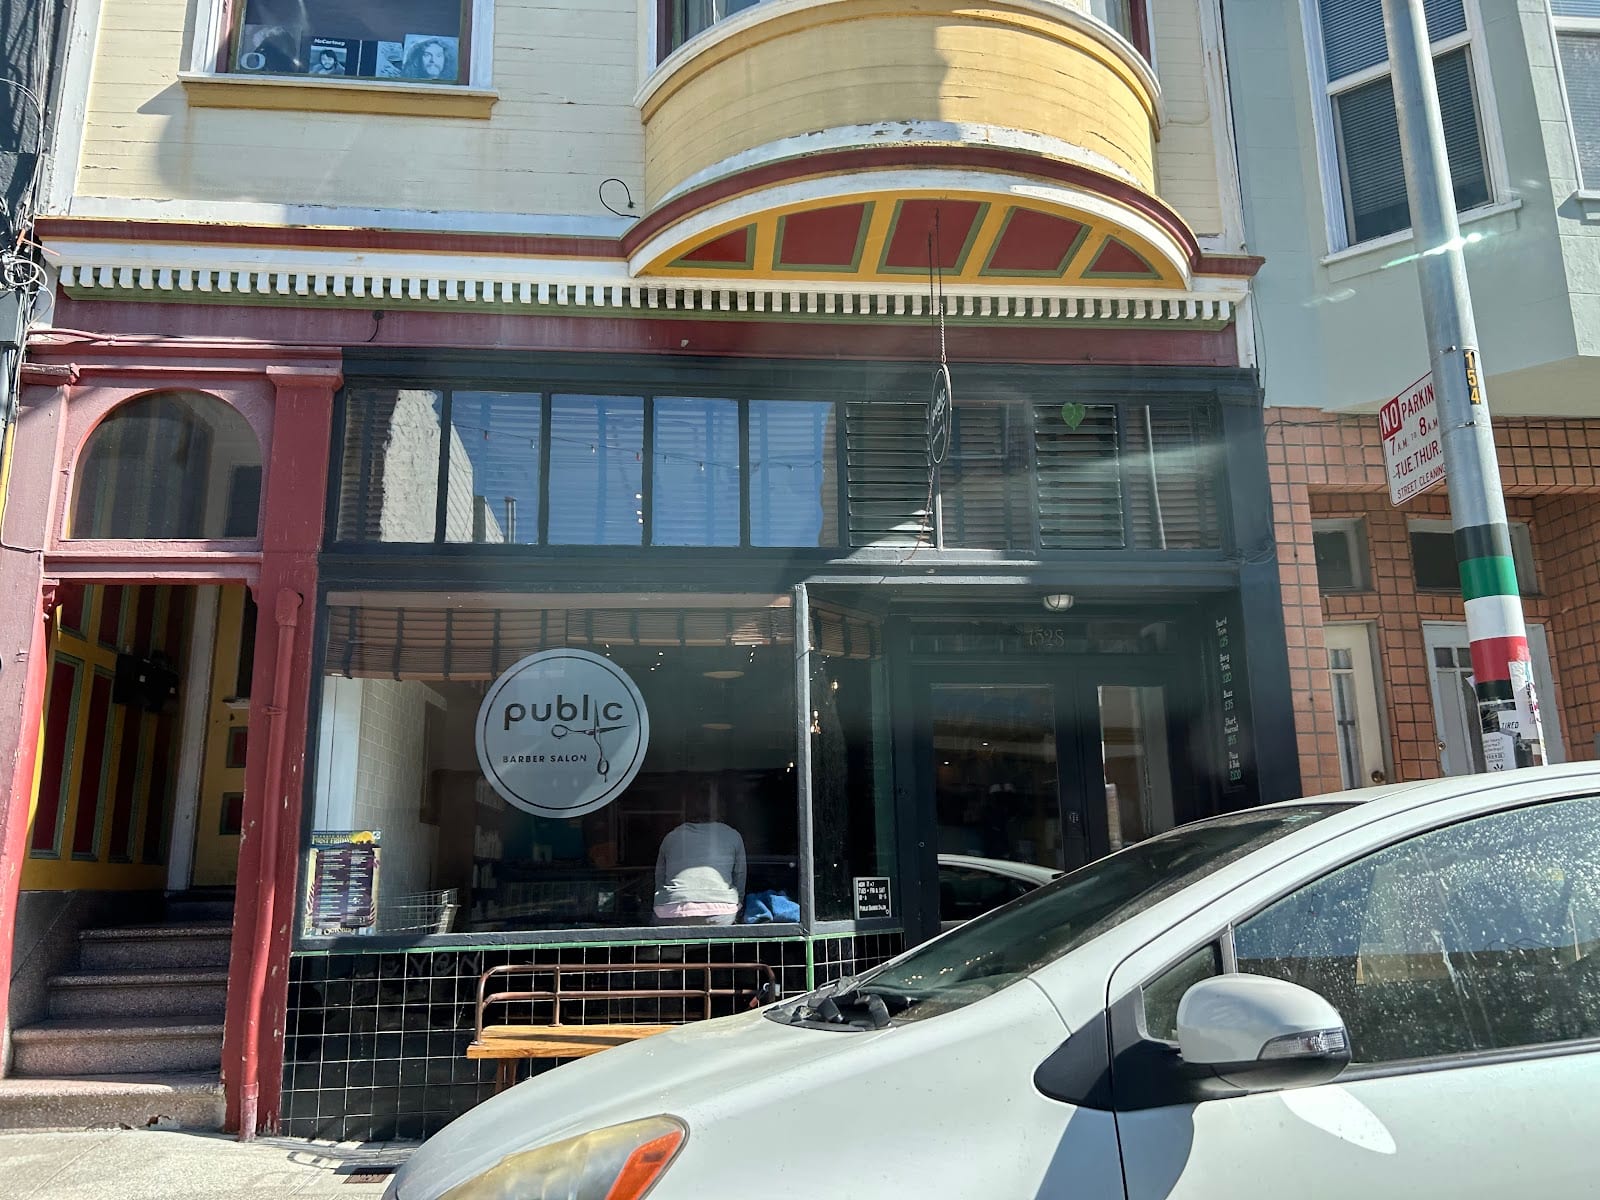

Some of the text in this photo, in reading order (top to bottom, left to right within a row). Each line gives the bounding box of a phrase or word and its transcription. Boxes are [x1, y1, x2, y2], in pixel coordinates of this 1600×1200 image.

[313, 38, 345, 46] McCartney
[1464, 351, 1480, 404] 154
[1381, 383, 1434, 435] NO PARKIN
[1389, 436, 1396, 456] 7
[1419, 416, 1426, 437] 8
[1397, 479, 1418, 500] STREET
[504, 694, 623, 730] public
[503, 754, 587, 763] BARBER SALON
